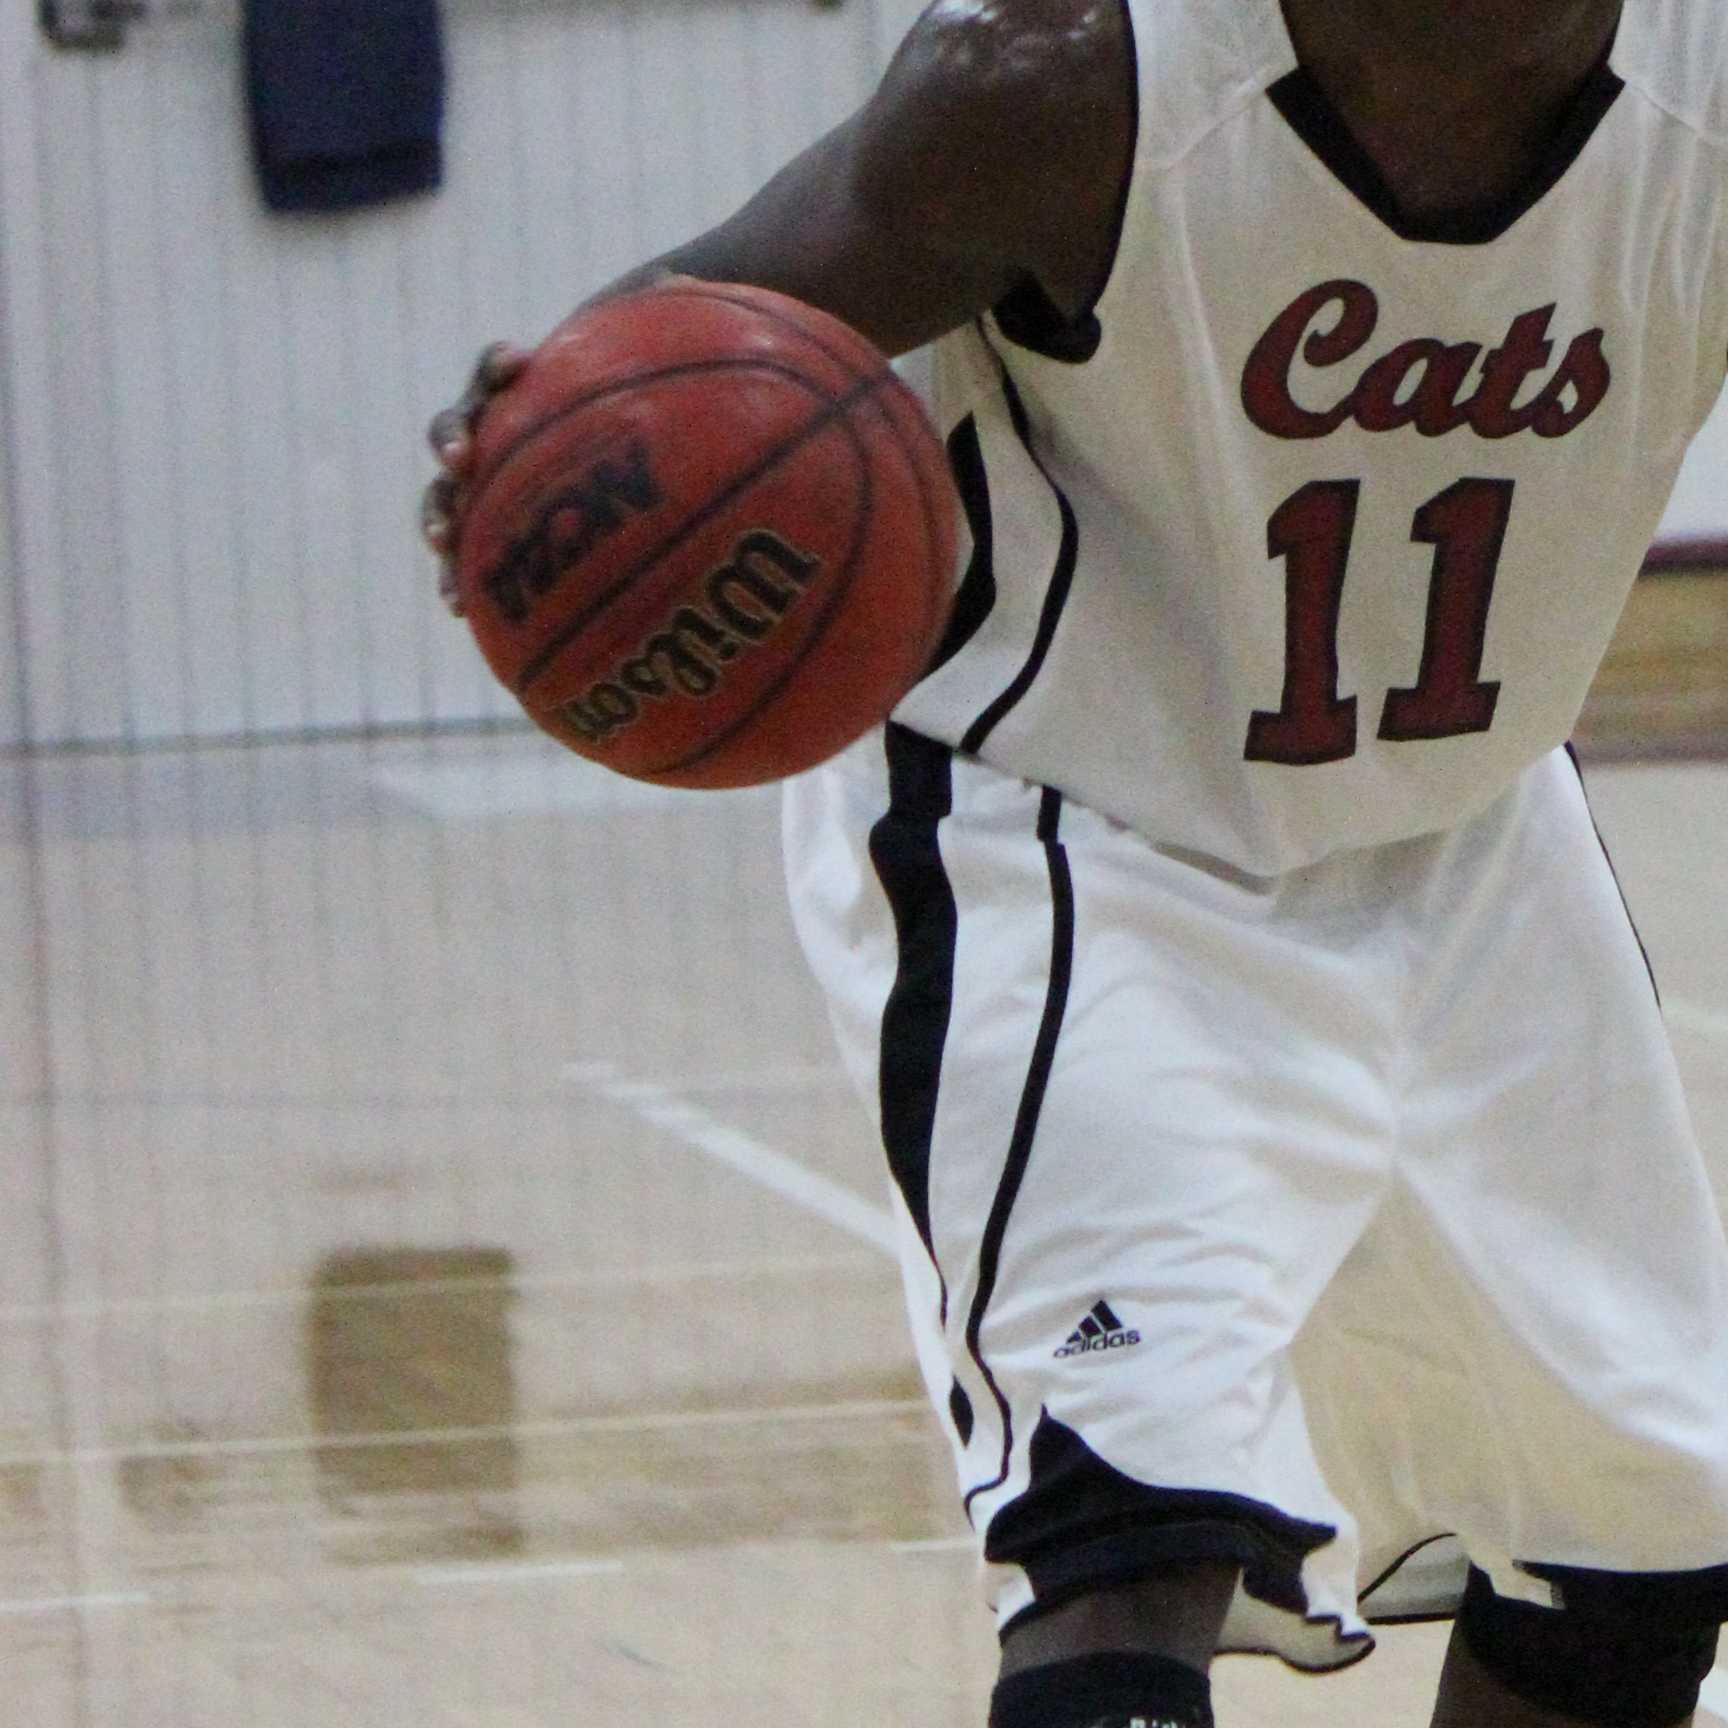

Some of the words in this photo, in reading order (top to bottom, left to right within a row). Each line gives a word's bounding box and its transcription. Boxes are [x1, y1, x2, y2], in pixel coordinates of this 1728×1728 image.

[1240, 278, 1611, 440] Cats
[560, 529, 826, 742] Wilson
[1243, 476, 1516, 766] 11
[1053, 1329, 1140, 1358] adidas
